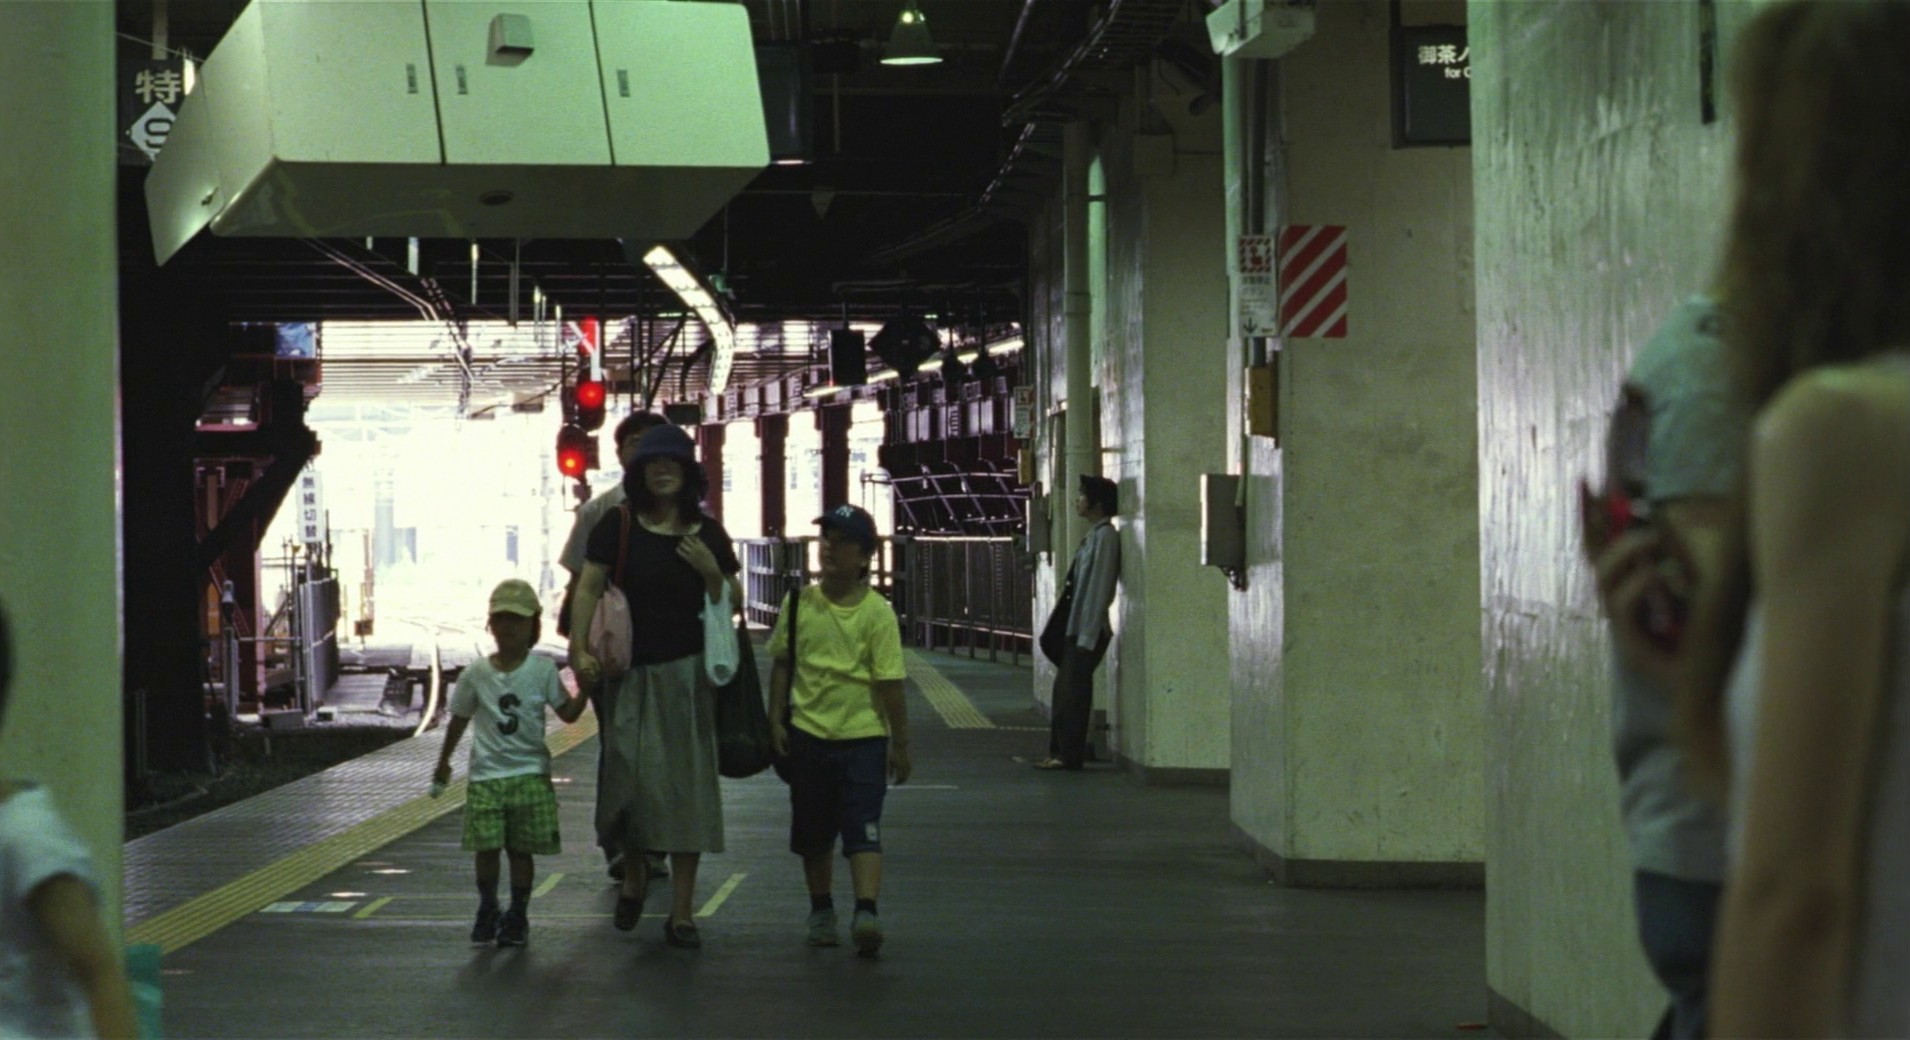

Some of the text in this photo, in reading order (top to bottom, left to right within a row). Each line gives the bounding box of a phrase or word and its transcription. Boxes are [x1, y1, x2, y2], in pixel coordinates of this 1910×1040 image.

[135, 70, 181, 104] 特
[1445, 67, 1461, 78] for
[497, 693, 521, 735] S
